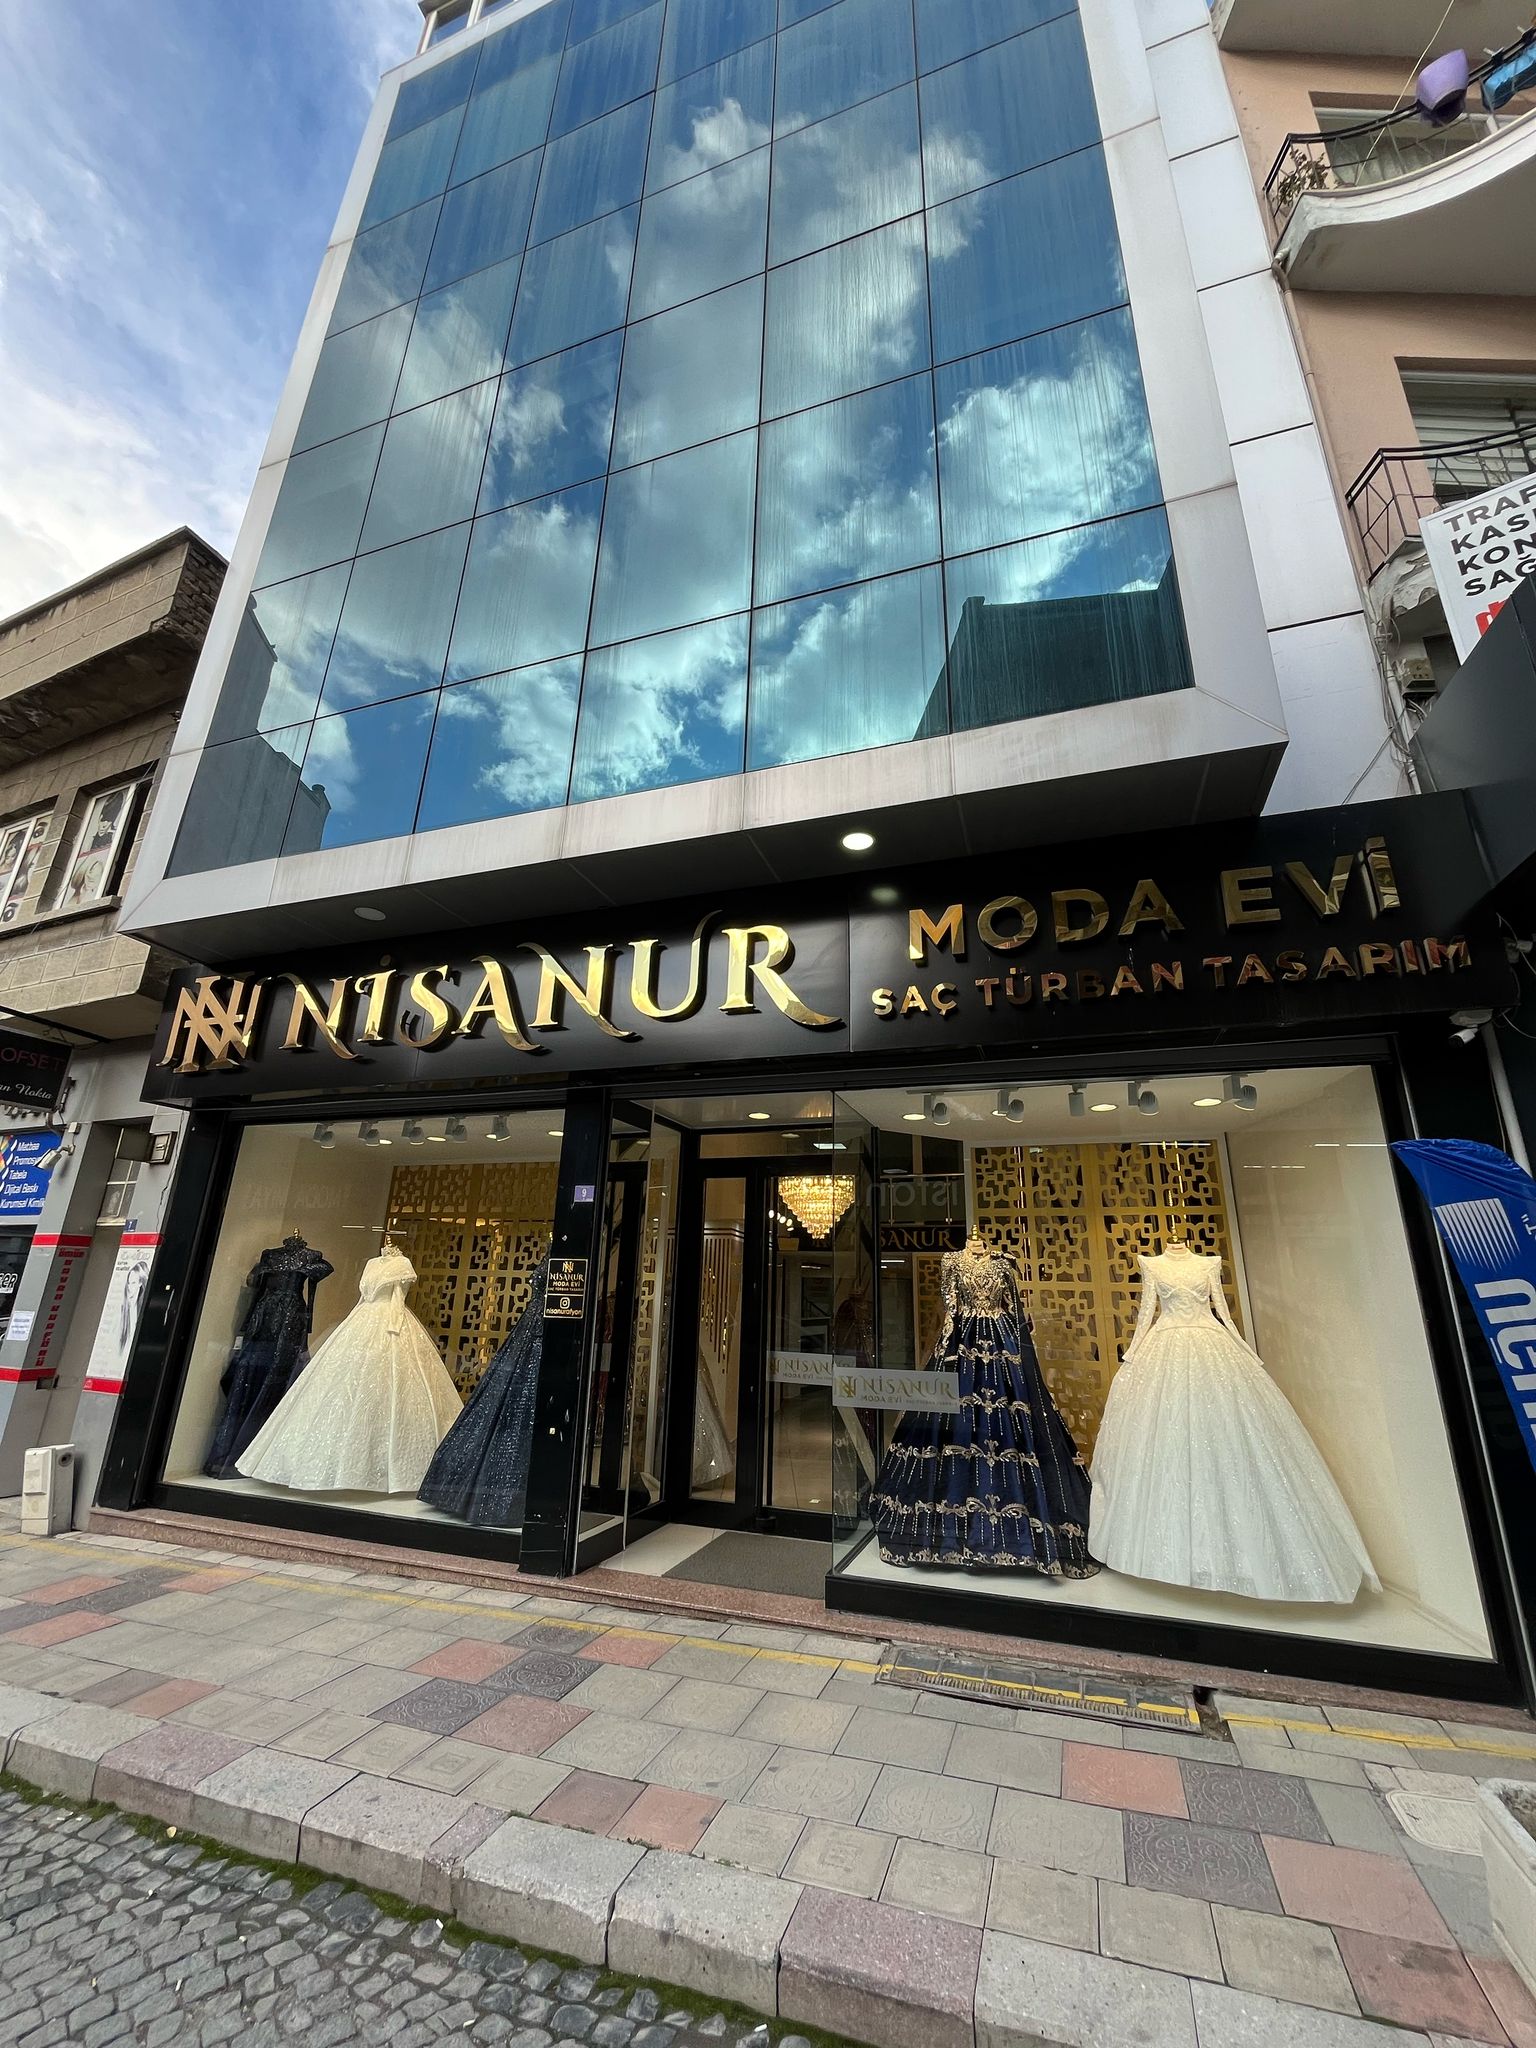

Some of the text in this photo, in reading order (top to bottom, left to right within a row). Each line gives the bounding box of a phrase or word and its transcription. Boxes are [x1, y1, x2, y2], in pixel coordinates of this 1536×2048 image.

[1451, 509, 1536, 554] KAS
[909, 836, 1400, 960] MODA EVİ
[278, 910, 843, 1060] NİSANUR
[871, 935, 1472, 1016] SAÇ TÜRBAN TASARIM
